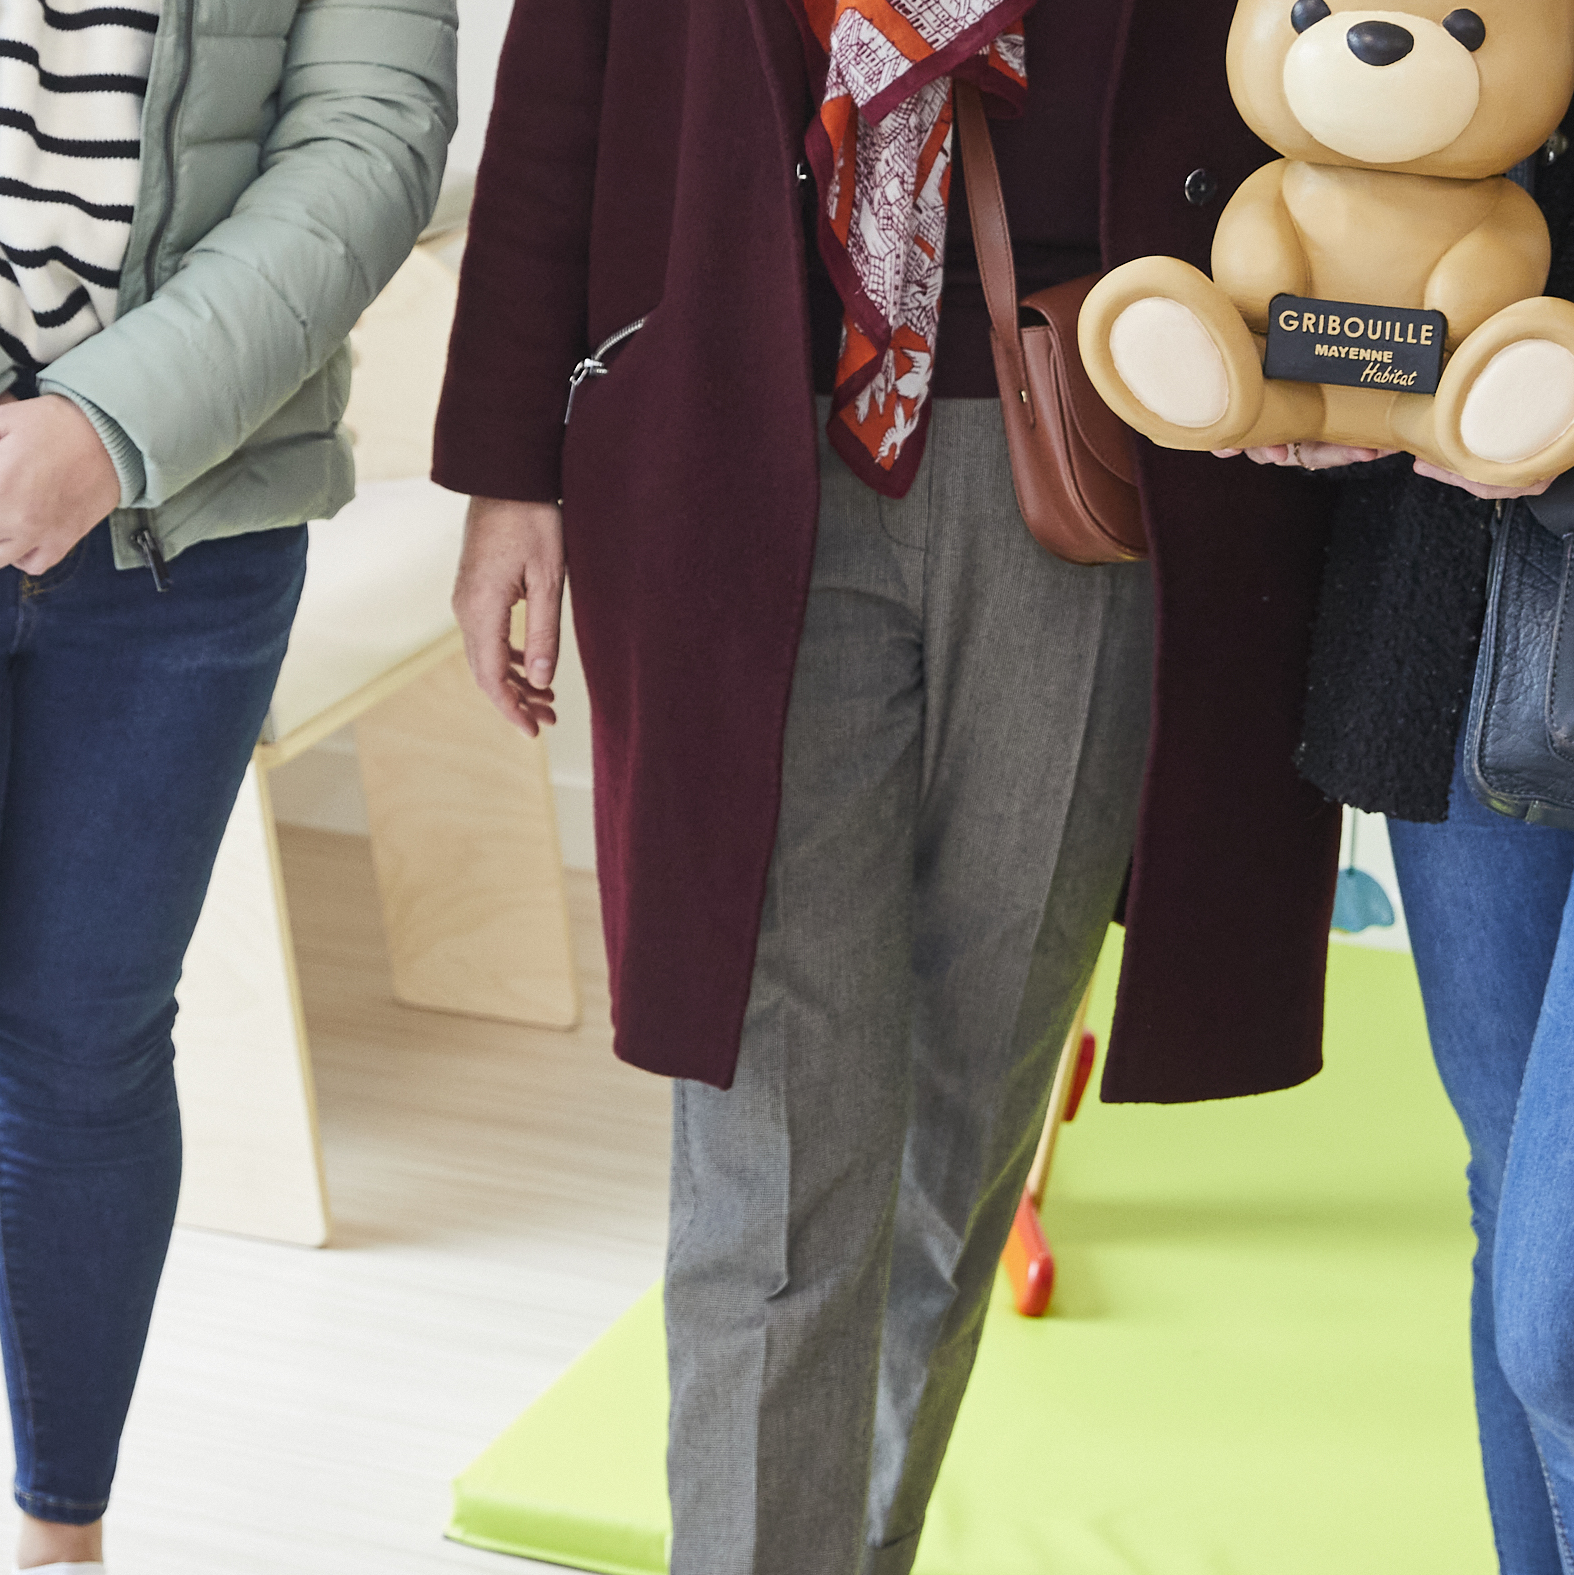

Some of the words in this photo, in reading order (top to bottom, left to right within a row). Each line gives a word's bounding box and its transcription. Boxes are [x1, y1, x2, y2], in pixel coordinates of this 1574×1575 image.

[1278, 310, 1434, 345] GRIBOUILLE
[1314, 343, 1394, 363] MAYENNE
[1360, 361, 1418, 386] Habitat
